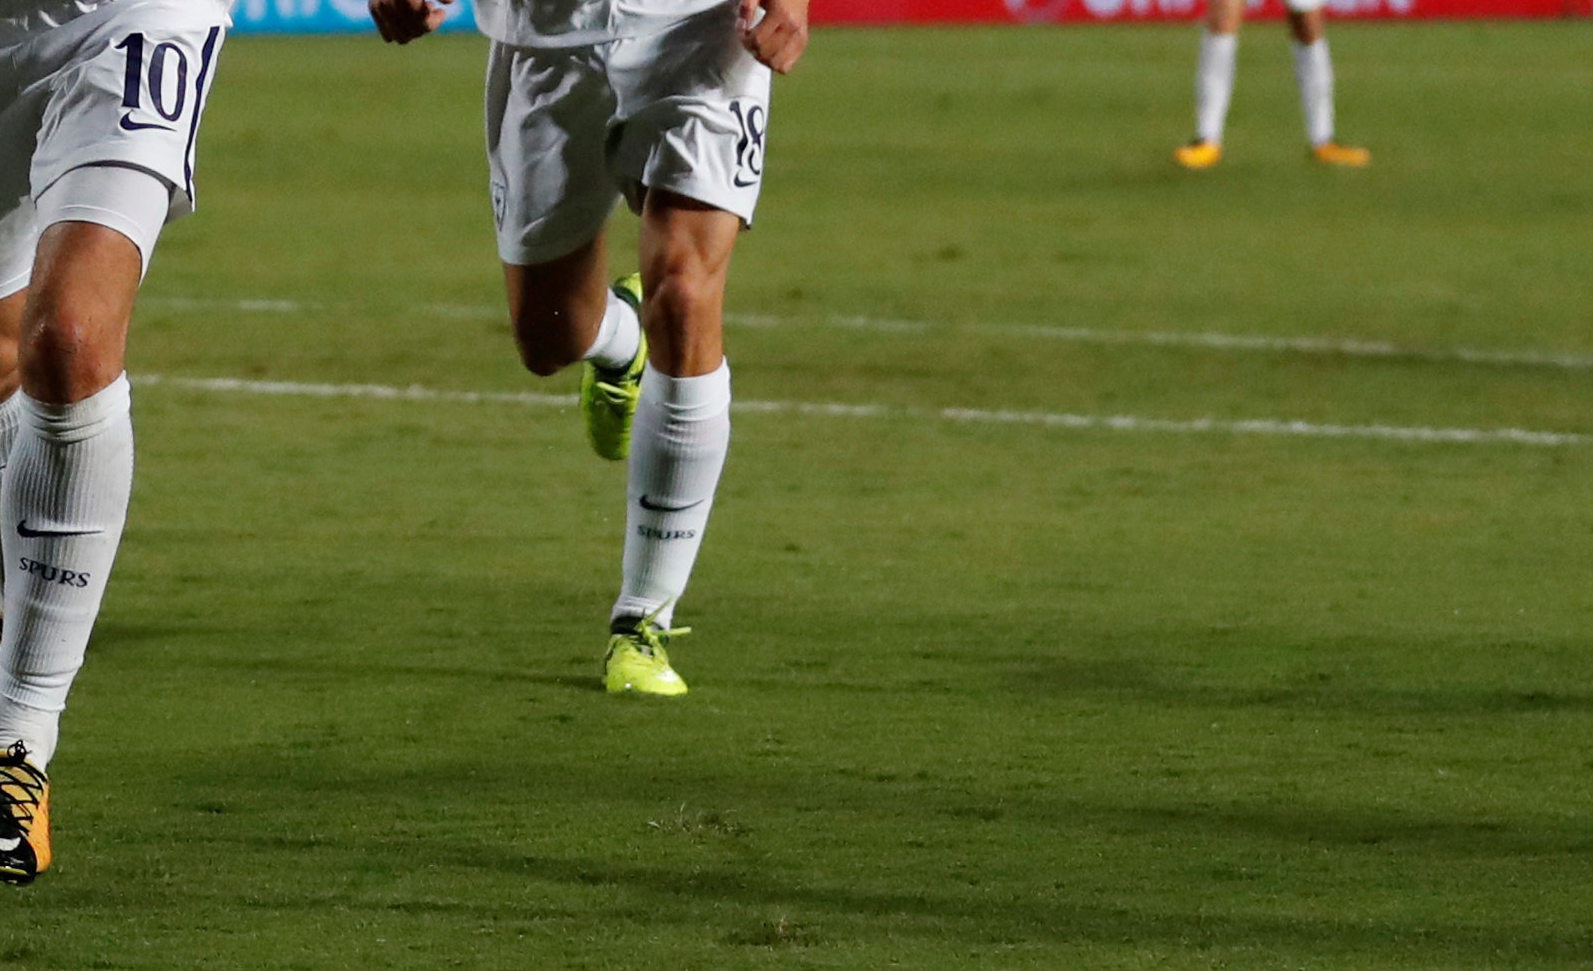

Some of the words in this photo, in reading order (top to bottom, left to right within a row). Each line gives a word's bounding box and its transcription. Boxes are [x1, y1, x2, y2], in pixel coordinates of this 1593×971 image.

[114, 32, 188, 122] 10
[729, 100, 765, 176] 18
[638, 524, 696, 540] SPURS
[19, 557, 91, 588] SPURS
